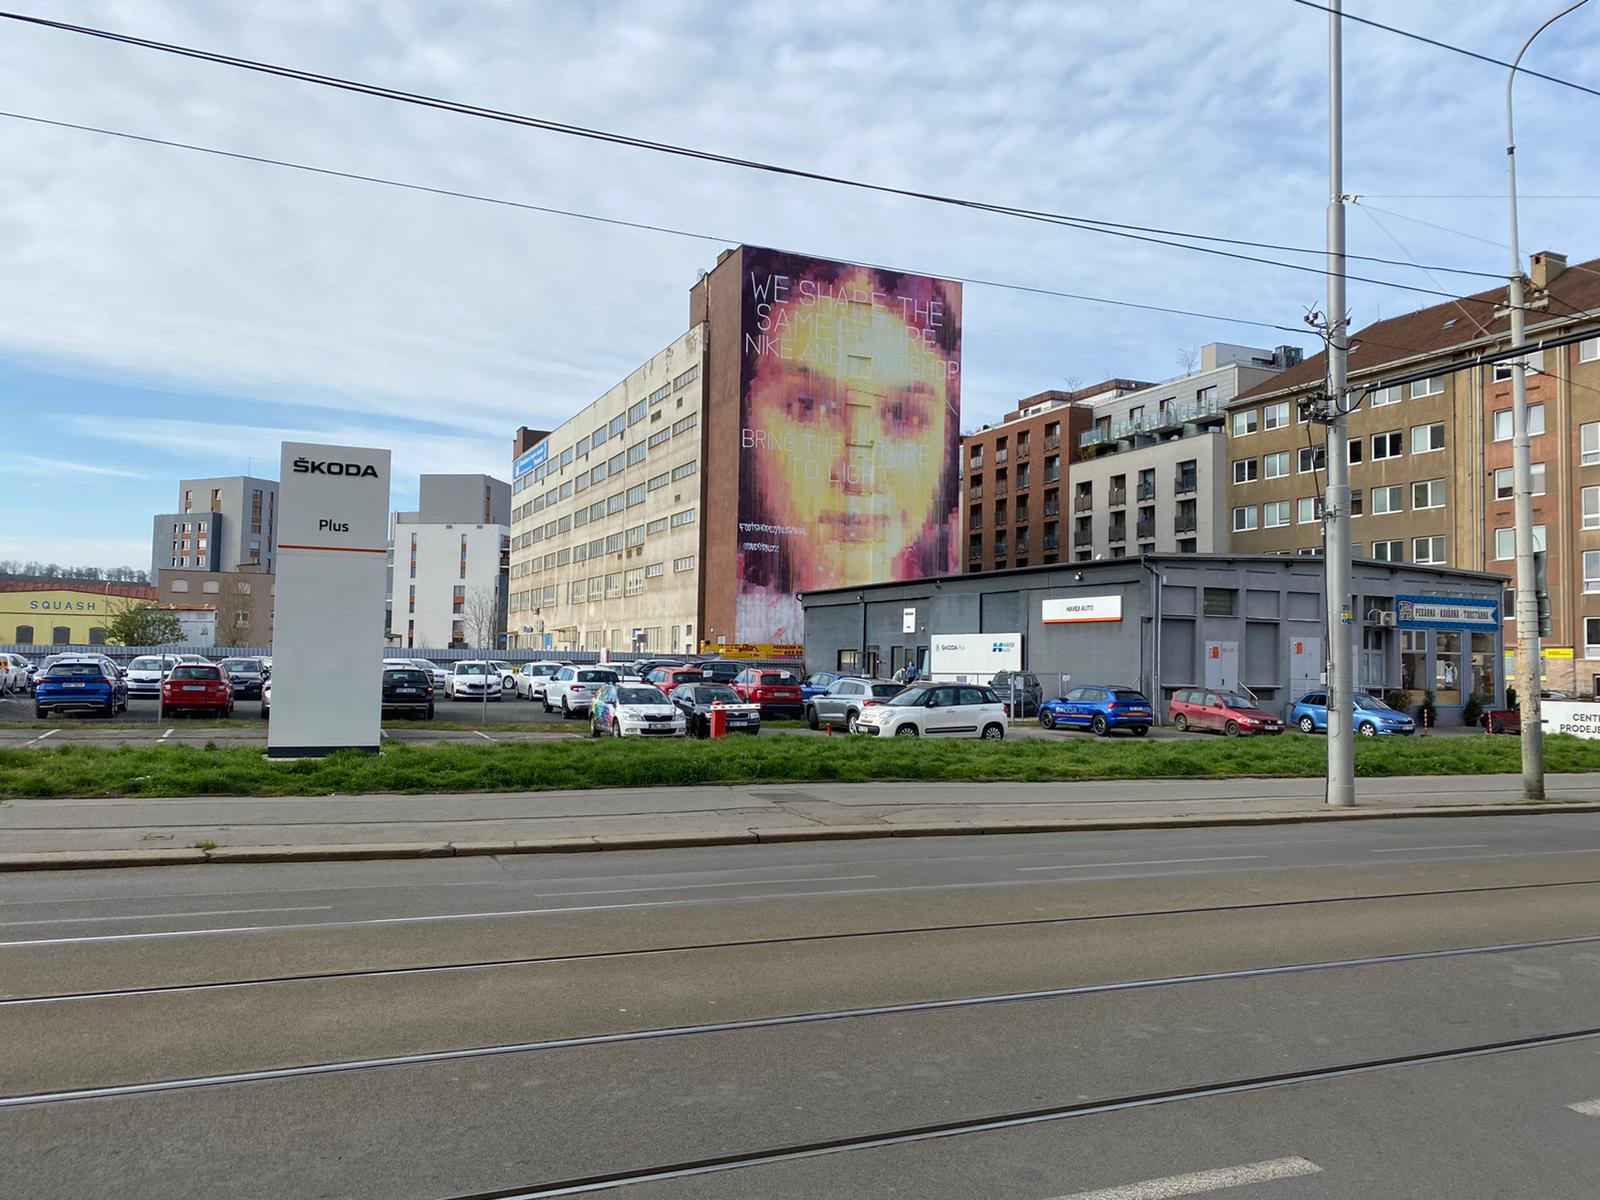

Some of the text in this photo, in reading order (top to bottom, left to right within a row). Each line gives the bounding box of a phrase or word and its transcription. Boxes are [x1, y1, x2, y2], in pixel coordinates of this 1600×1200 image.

[751, 271, 944, 327] WE SHARE THE
[756, 303, 832, 341] SAME
[745, 333, 793, 360] NIKE
[799, 343, 842, 365] AND
[742, 428, 796, 453] BRING
[805, 434, 841, 457] THE
[293, 456, 379, 478] ŠKODA
[788, 457, 891, 485] TO LIGHT
[319, 519, 350, 532] Plus
[30, 600, 96, 611] SQUASH
[1081, 604, 1094, 612] AUTO
